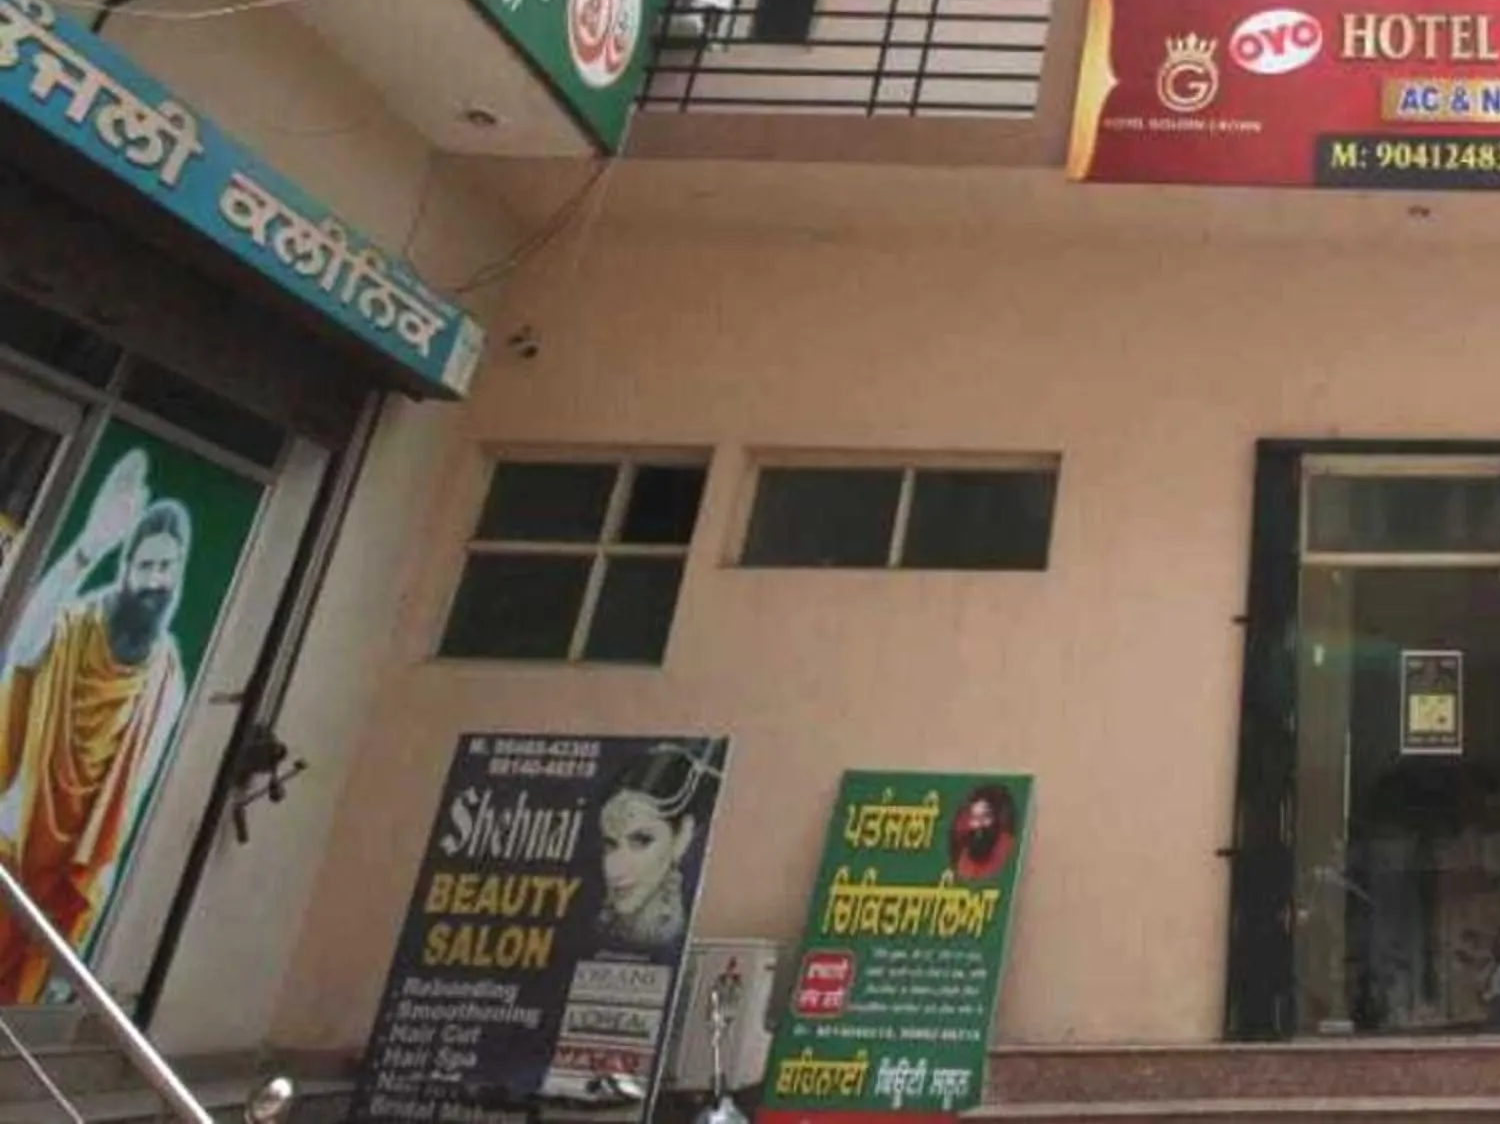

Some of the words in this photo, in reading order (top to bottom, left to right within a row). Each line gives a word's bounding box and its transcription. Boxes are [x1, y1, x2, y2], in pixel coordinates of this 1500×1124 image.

[1232, 16, 1321, 69] OYO
[1341, 12, 1499, 63] HOTEL
[1400, 89, 1438, 113] AC
[1450, 91, 1470, 113] &
[1330, 142, 1367, 169] M:
[442, 787, 586, 860] Shehnai
[425, 875, 582, 916] BEAUTY
[425, 926, 553, 967] SALON
